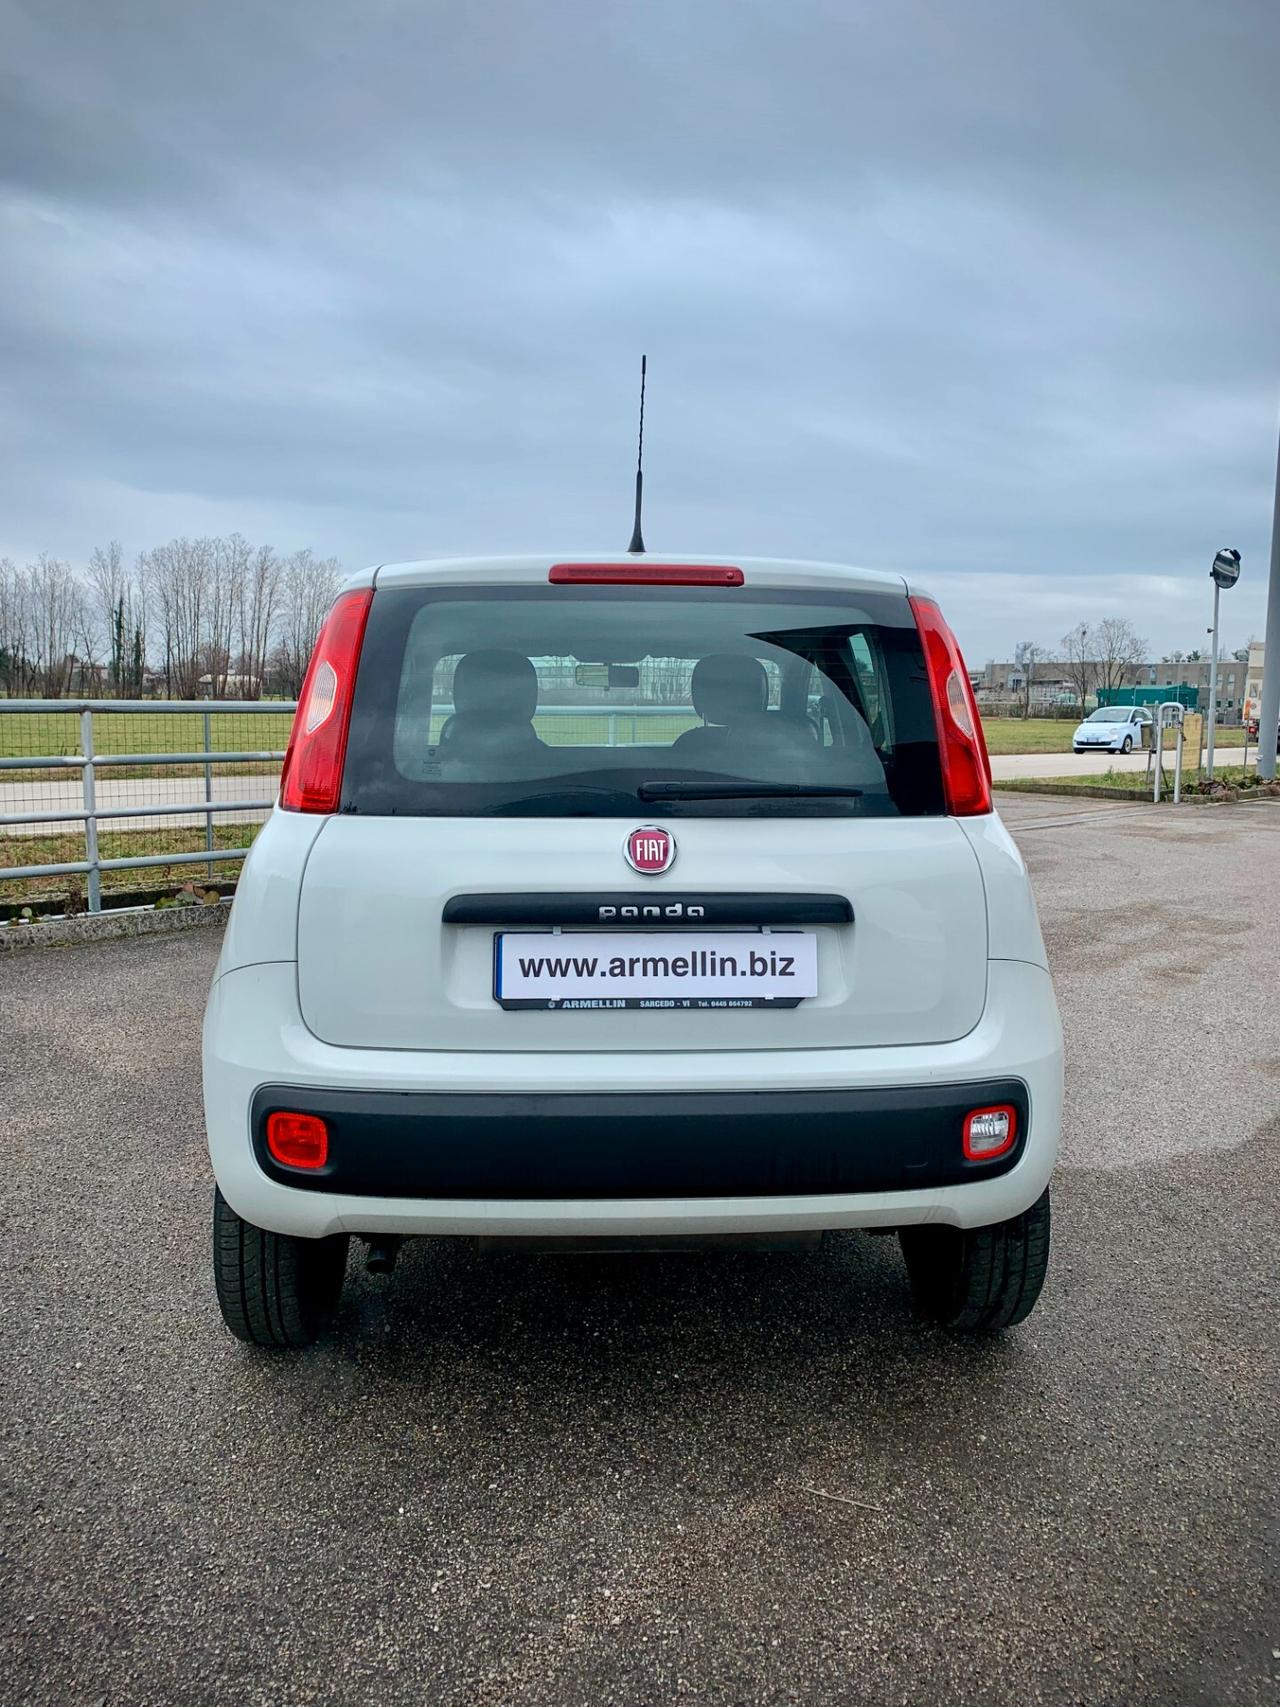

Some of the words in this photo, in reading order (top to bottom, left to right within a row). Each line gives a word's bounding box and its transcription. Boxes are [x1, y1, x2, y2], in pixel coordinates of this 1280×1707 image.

[636, 839, 666, 861] FIAT
[599, 903, 704, 920] panda
[519, 951, 795, 977] www.armellin.biz
[562, 1000, 626, 1008] ARMELLIN
[640, 1000, 675, 1008] SARCEDO
